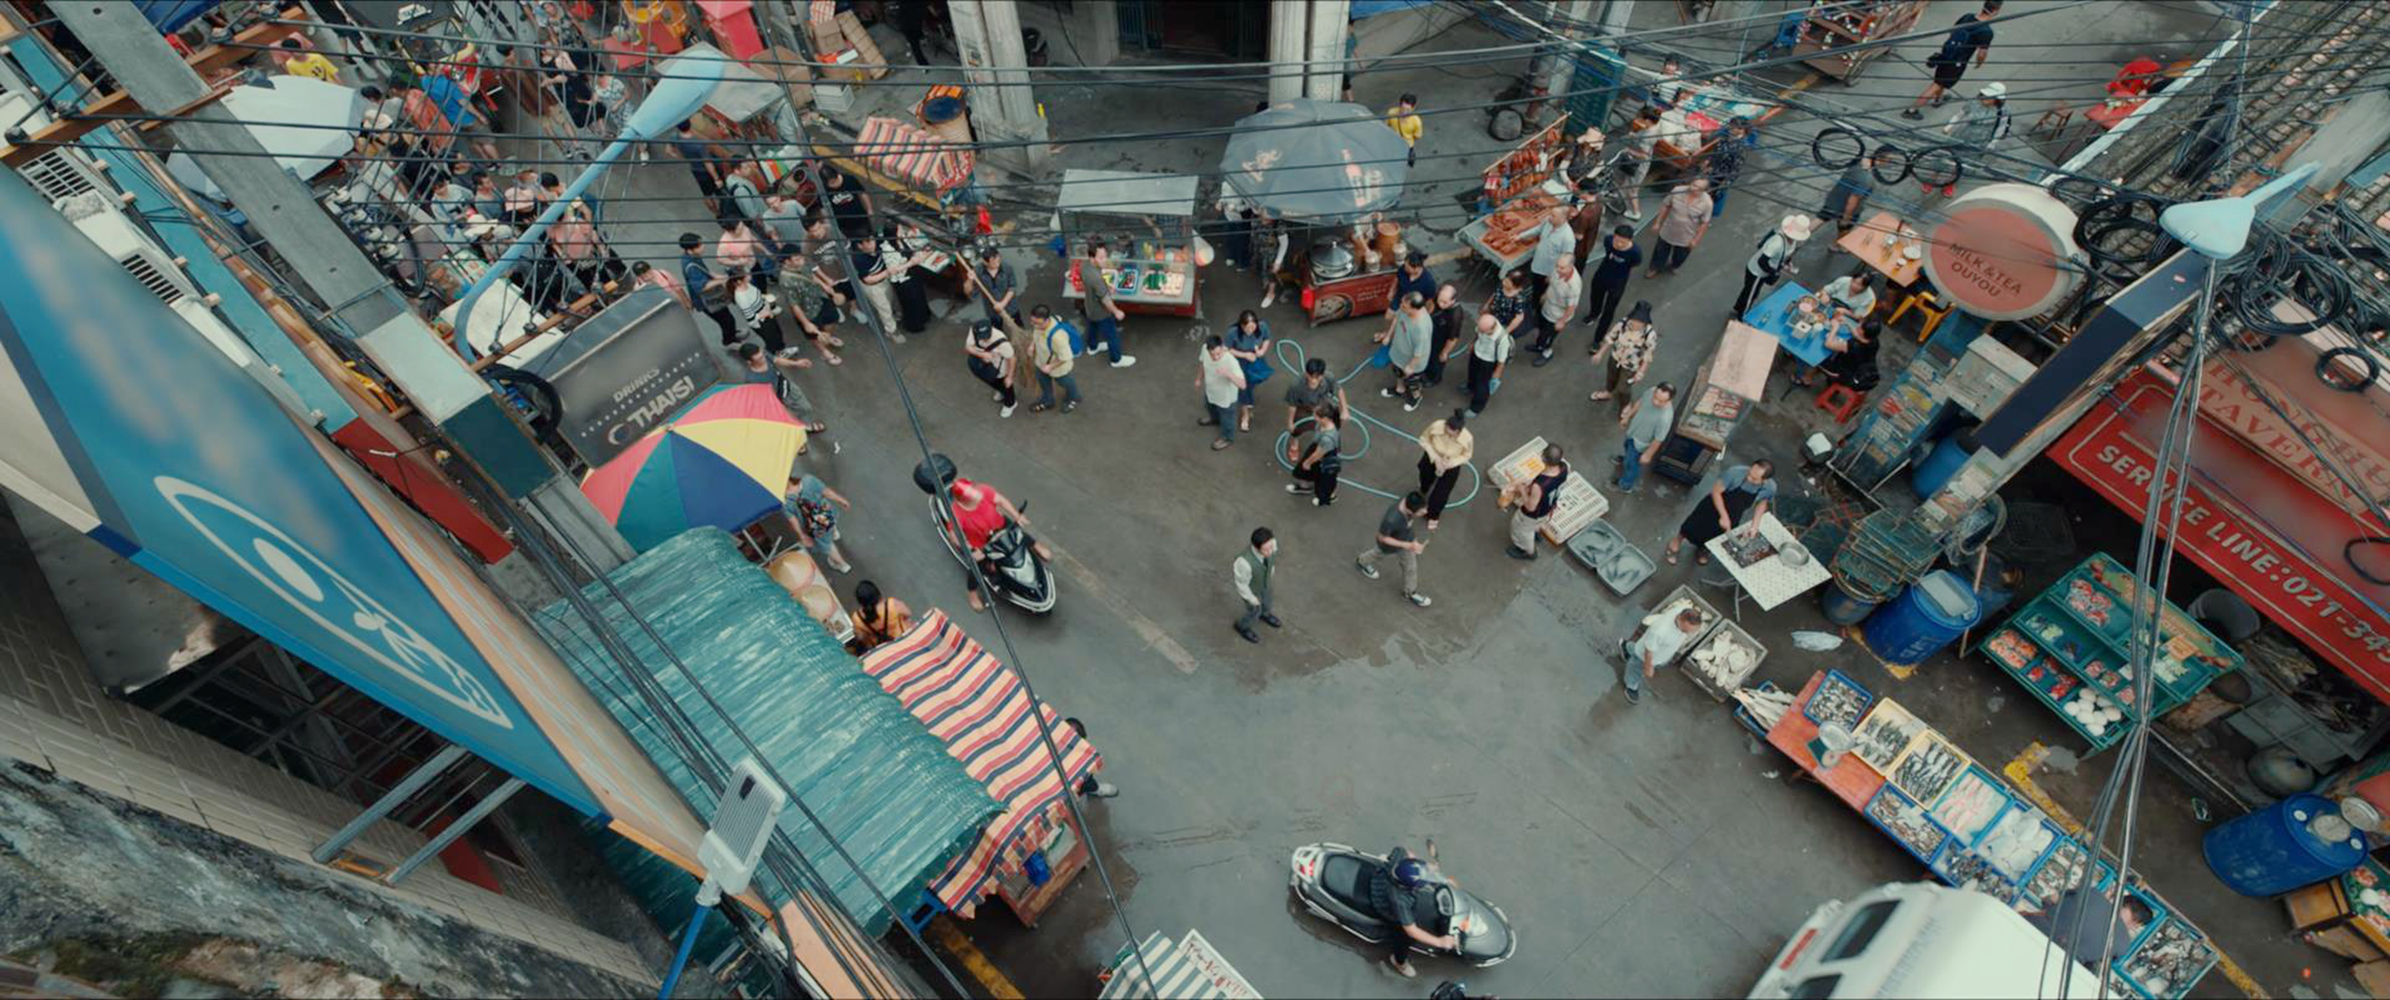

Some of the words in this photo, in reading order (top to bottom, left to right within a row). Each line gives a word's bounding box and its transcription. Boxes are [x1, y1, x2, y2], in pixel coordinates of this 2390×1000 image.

[1950, 243, 1984, 269] MILK
[1951, 262, 2001, 297] OUYOU
[2200, 383, 2354, 499] TAVERN
